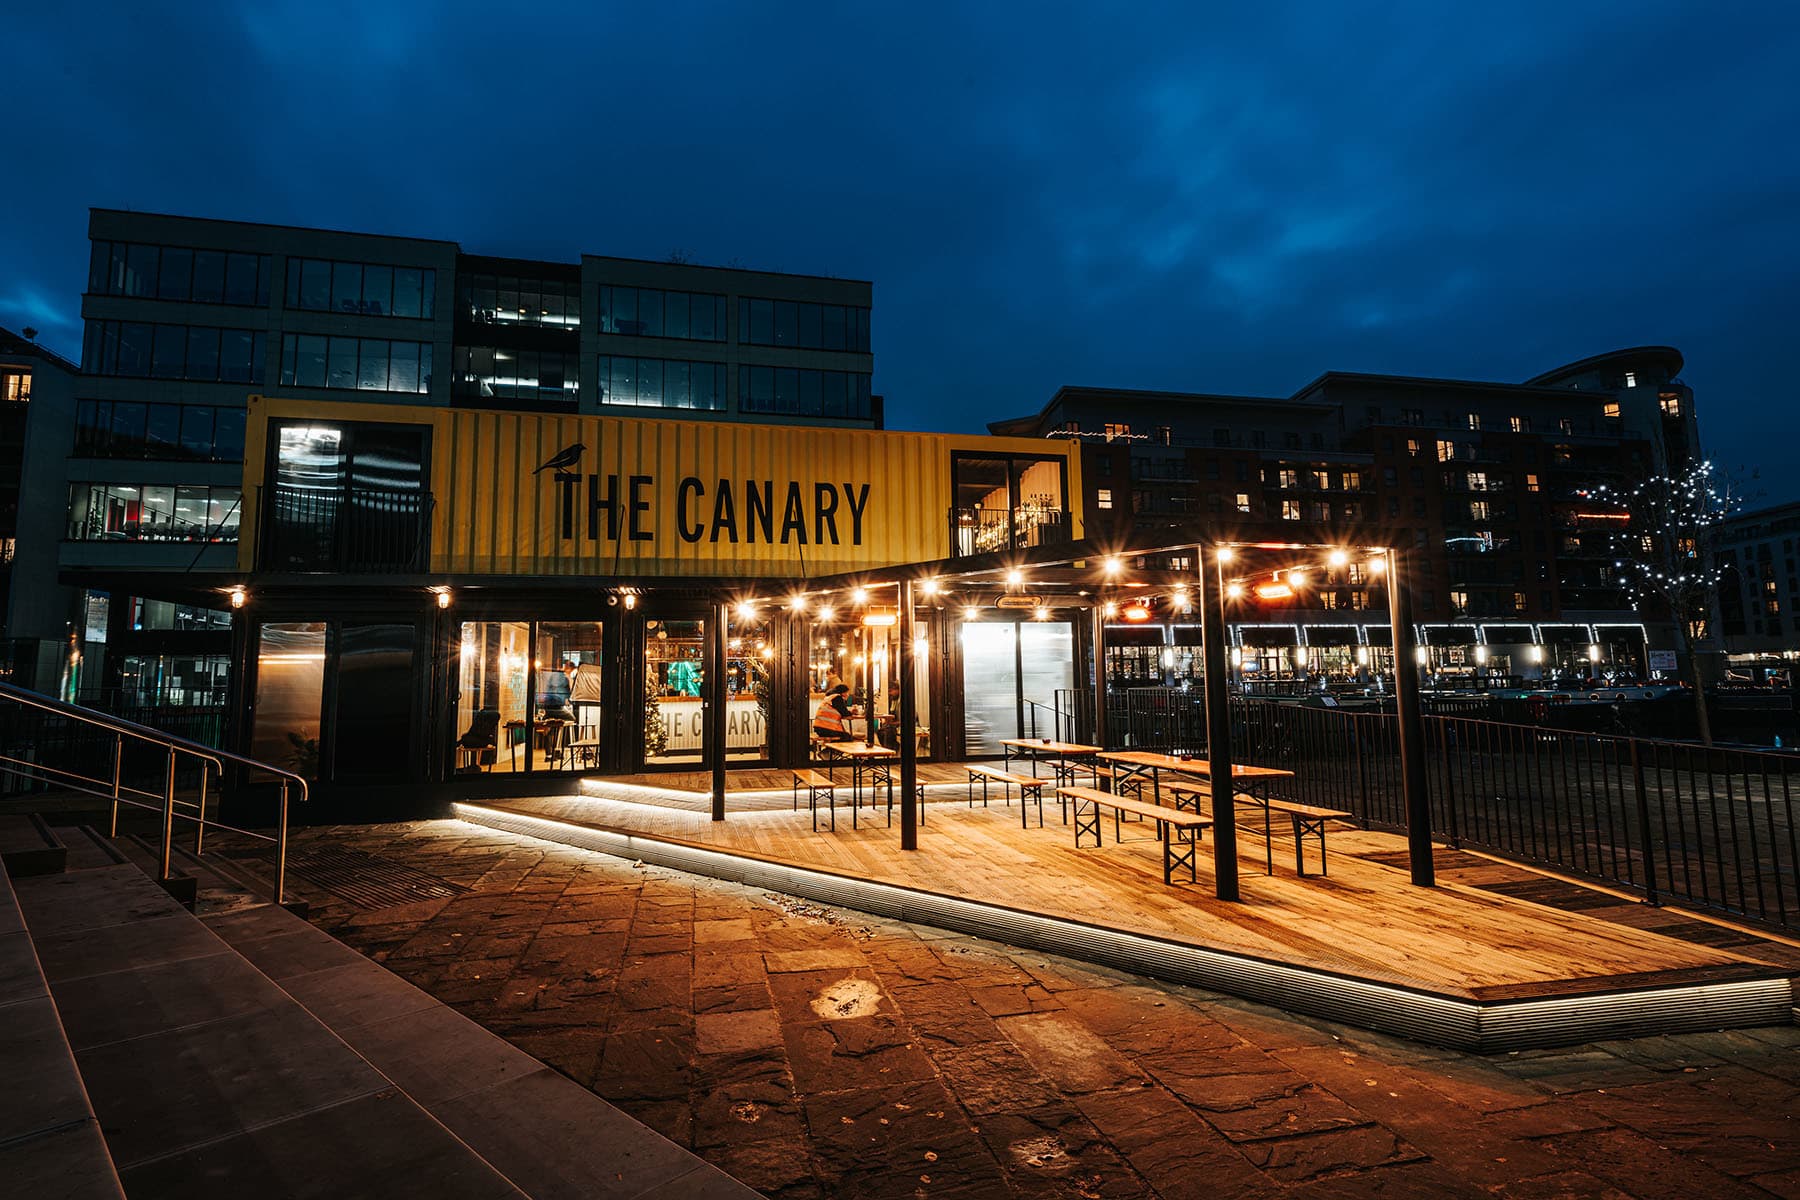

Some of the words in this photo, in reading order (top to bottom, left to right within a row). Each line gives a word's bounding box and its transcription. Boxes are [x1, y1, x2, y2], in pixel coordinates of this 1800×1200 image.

[554, 473, 654, 541] THE
[677, 477, 871, 546] CANARY
[661, 712, 683, 737] HE
[692, 711, 761, 737] CARY
